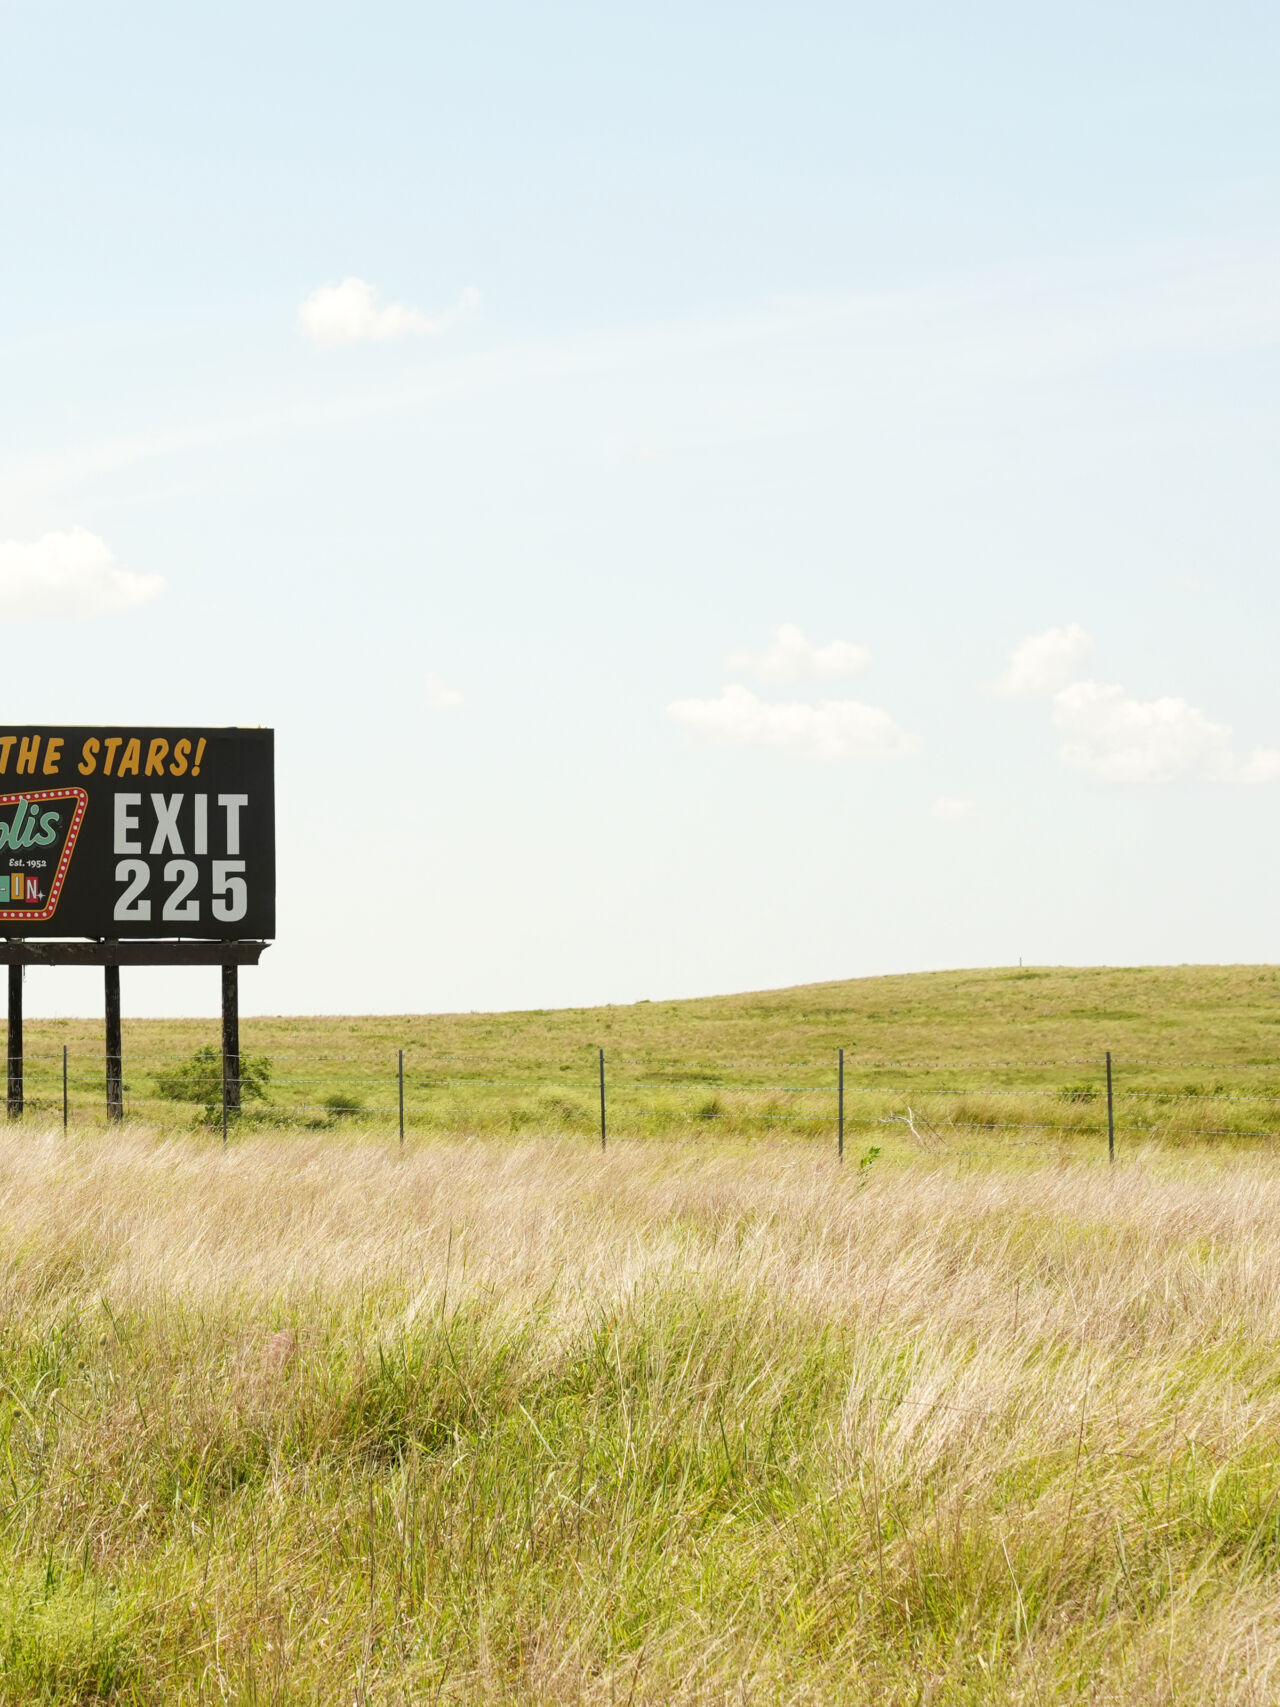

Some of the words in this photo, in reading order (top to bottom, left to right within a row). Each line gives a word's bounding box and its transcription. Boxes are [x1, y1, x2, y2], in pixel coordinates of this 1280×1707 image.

[77, 736, 207, 777] STARS!
[113, 792, 249, 855] EXIT
[8, 858, 25, 867] Est.
[26, 859, 47, 869] 1952
[113, 858, 248, 922] 225
